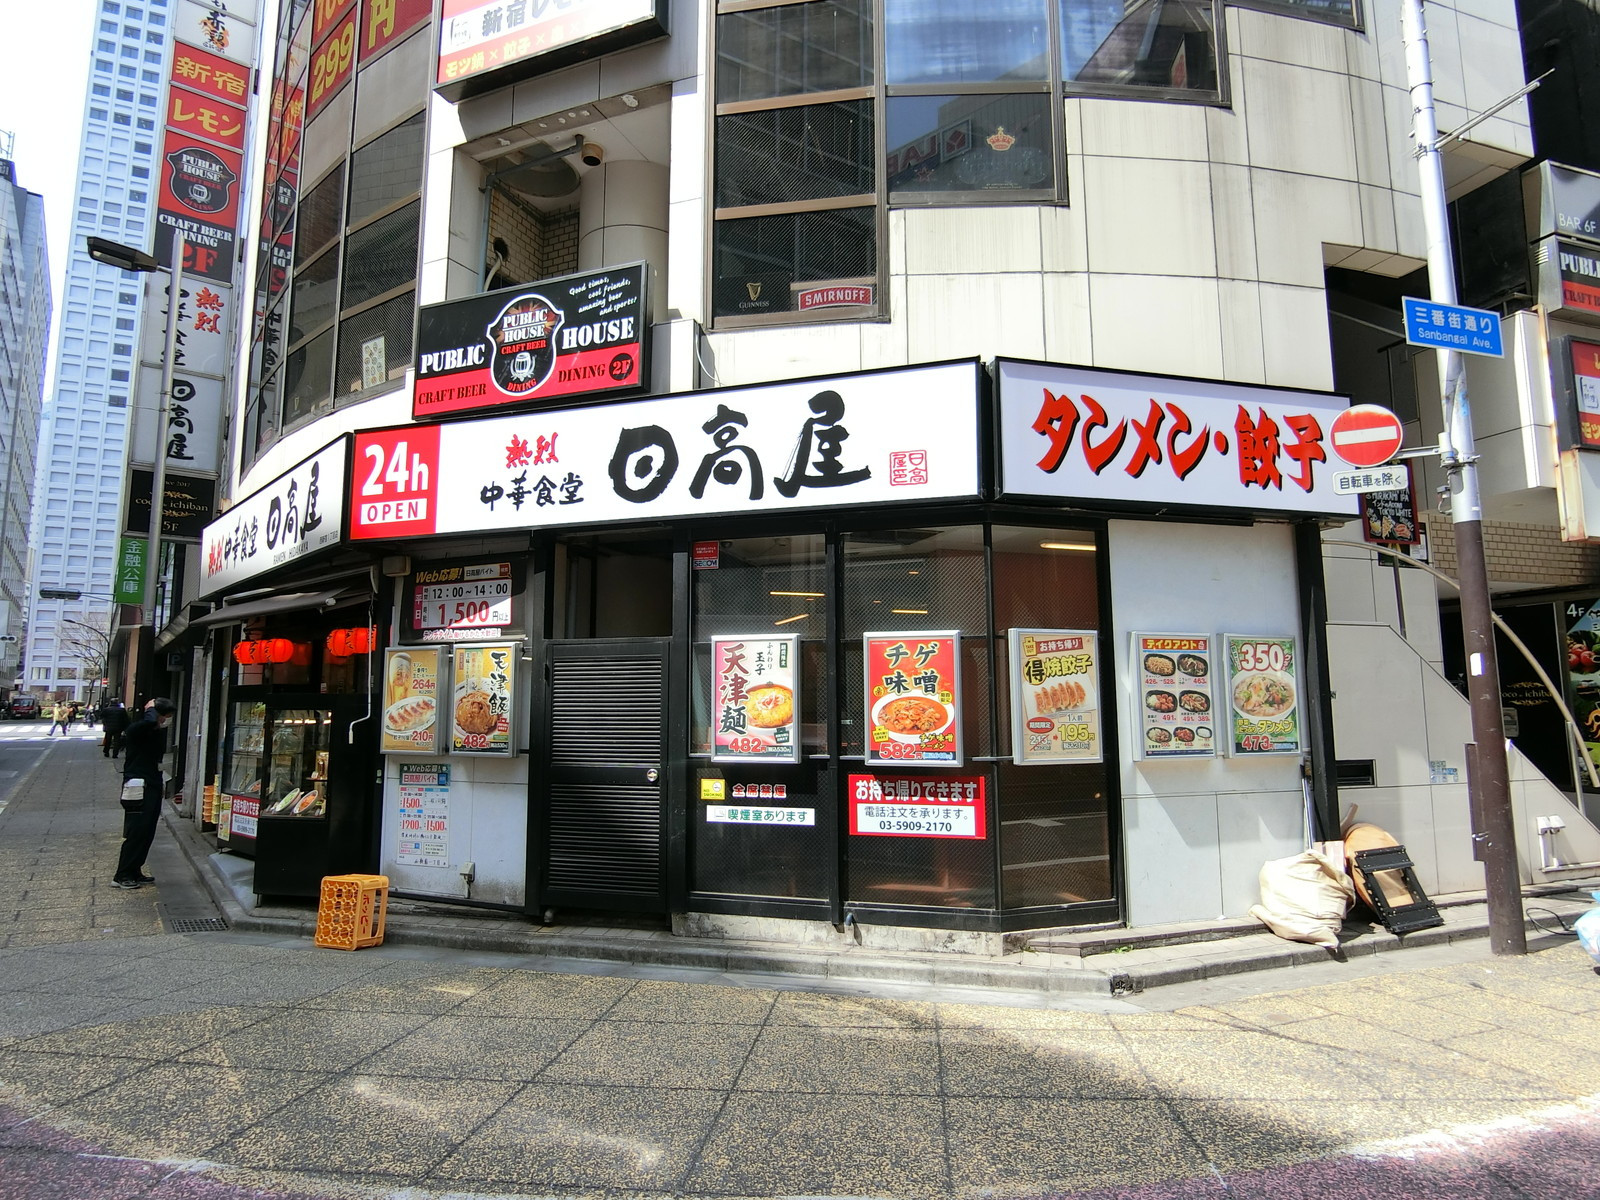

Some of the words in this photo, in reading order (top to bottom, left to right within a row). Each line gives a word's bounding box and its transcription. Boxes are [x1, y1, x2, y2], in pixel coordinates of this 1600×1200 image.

[311, 22, 354, 104] 299
[175, 56, 246, 97] 新宿
[173, 98, 241, 137] レモン
[181, 153, 223, 174] PUBLIC
[182, 164, 221, 182] HOUSE
[159, 213, 199, 233] CRAFT
[200, 225, 232, 242] BEER
[1558, 213, 1581, 231] BAR
[1584, 219, 1597, 234] 6F
[569, 283, 587, 296] Good
[588, 287, 602, 299] cool
[602, 278, 631, 297] friends,
[805, 289, 866, 306] SMIRNOFF
[1564, 288, 1593, 306] CRAFT
[578, 298, 606, 313] amazing
[608, 292, 622, 302] beer
[599, 305, 613, 316] and
[739, 299, 769, 309] GUINNESS
[503, 308, 548, 329] PUBLIC
[1415, 306, 1493, 334] 三番街通り
[504, 322, 546, 343] HOUSE
[1418, 327, 1468, 345] Sanbangai
[1472, 336, 1493, 349] Ave.
[420, 344, 485, 374] PUBLIC
[562, 317, 634, 350] HOUSE
[501, 343, 525, 355] CRAFT
[526, 339, 547, 350] BEER
[418, 388, 456, 405] CRAFT
[457, 382, 487, 399] BEER
[558, 363, 605, 383] DINING
[612, 359, 631, 376] 2F
[506, 378, 537, 392] DINING
[505, 431, 559, 469] 熱烈
[608, 389, 872, 504] 日高屋
[1030, 387, 1327, 494] タンメン・餃子
[361, 440, 430, 497] 24h
[480, 468, 584, 512] 中華食堂
[1340, 472, 1402, 490] 自転車を除く
[169, 500, 208, 512] ichiban
[366, 503, 421, 523] OPEN
[162, 520, 179, 532] 5F
[122, 540, 143, 594] 金融公庫
[694, 559, 717, 567] SECOM
[438, 600, 490, 628] 1,500
[1566, 603, 1584, 618] 4F
[884, 642, 939, 668] チゲ
[1039, 639, 1079, 652] お持ち帰り
[1146, 639, 1197, 650] テイクアウト
[755, 652, 765, 675] 玉子
[1045, 654, 1092, 678] 焼餃子
[1241, 643, 1284, 671] 350
[412, 679, 436, 690] 264円
[490, 650, 509, 715] 天津飯
[719, 642, 750, 735] 天津麺
[884, 670, 940, 694] 味噌
[412, 731, 433, 742] 210円
[1058, 724, 1095, 742] 195円
[1257, 720, 1294, 734] タンメン
[728, 738, 766, 753] 482円
[879, 743, 923, 759] 582円
[732, 783, 787, 798] 全席禁煙
[855, 780, 978, 803] お持ち帰りできます
[727, 808, 808, 823] 喫煙室あります
[864, 805, 968, 821] 電話注文を承ります。
[879, 820, 952, 832] 03-5909-2170
